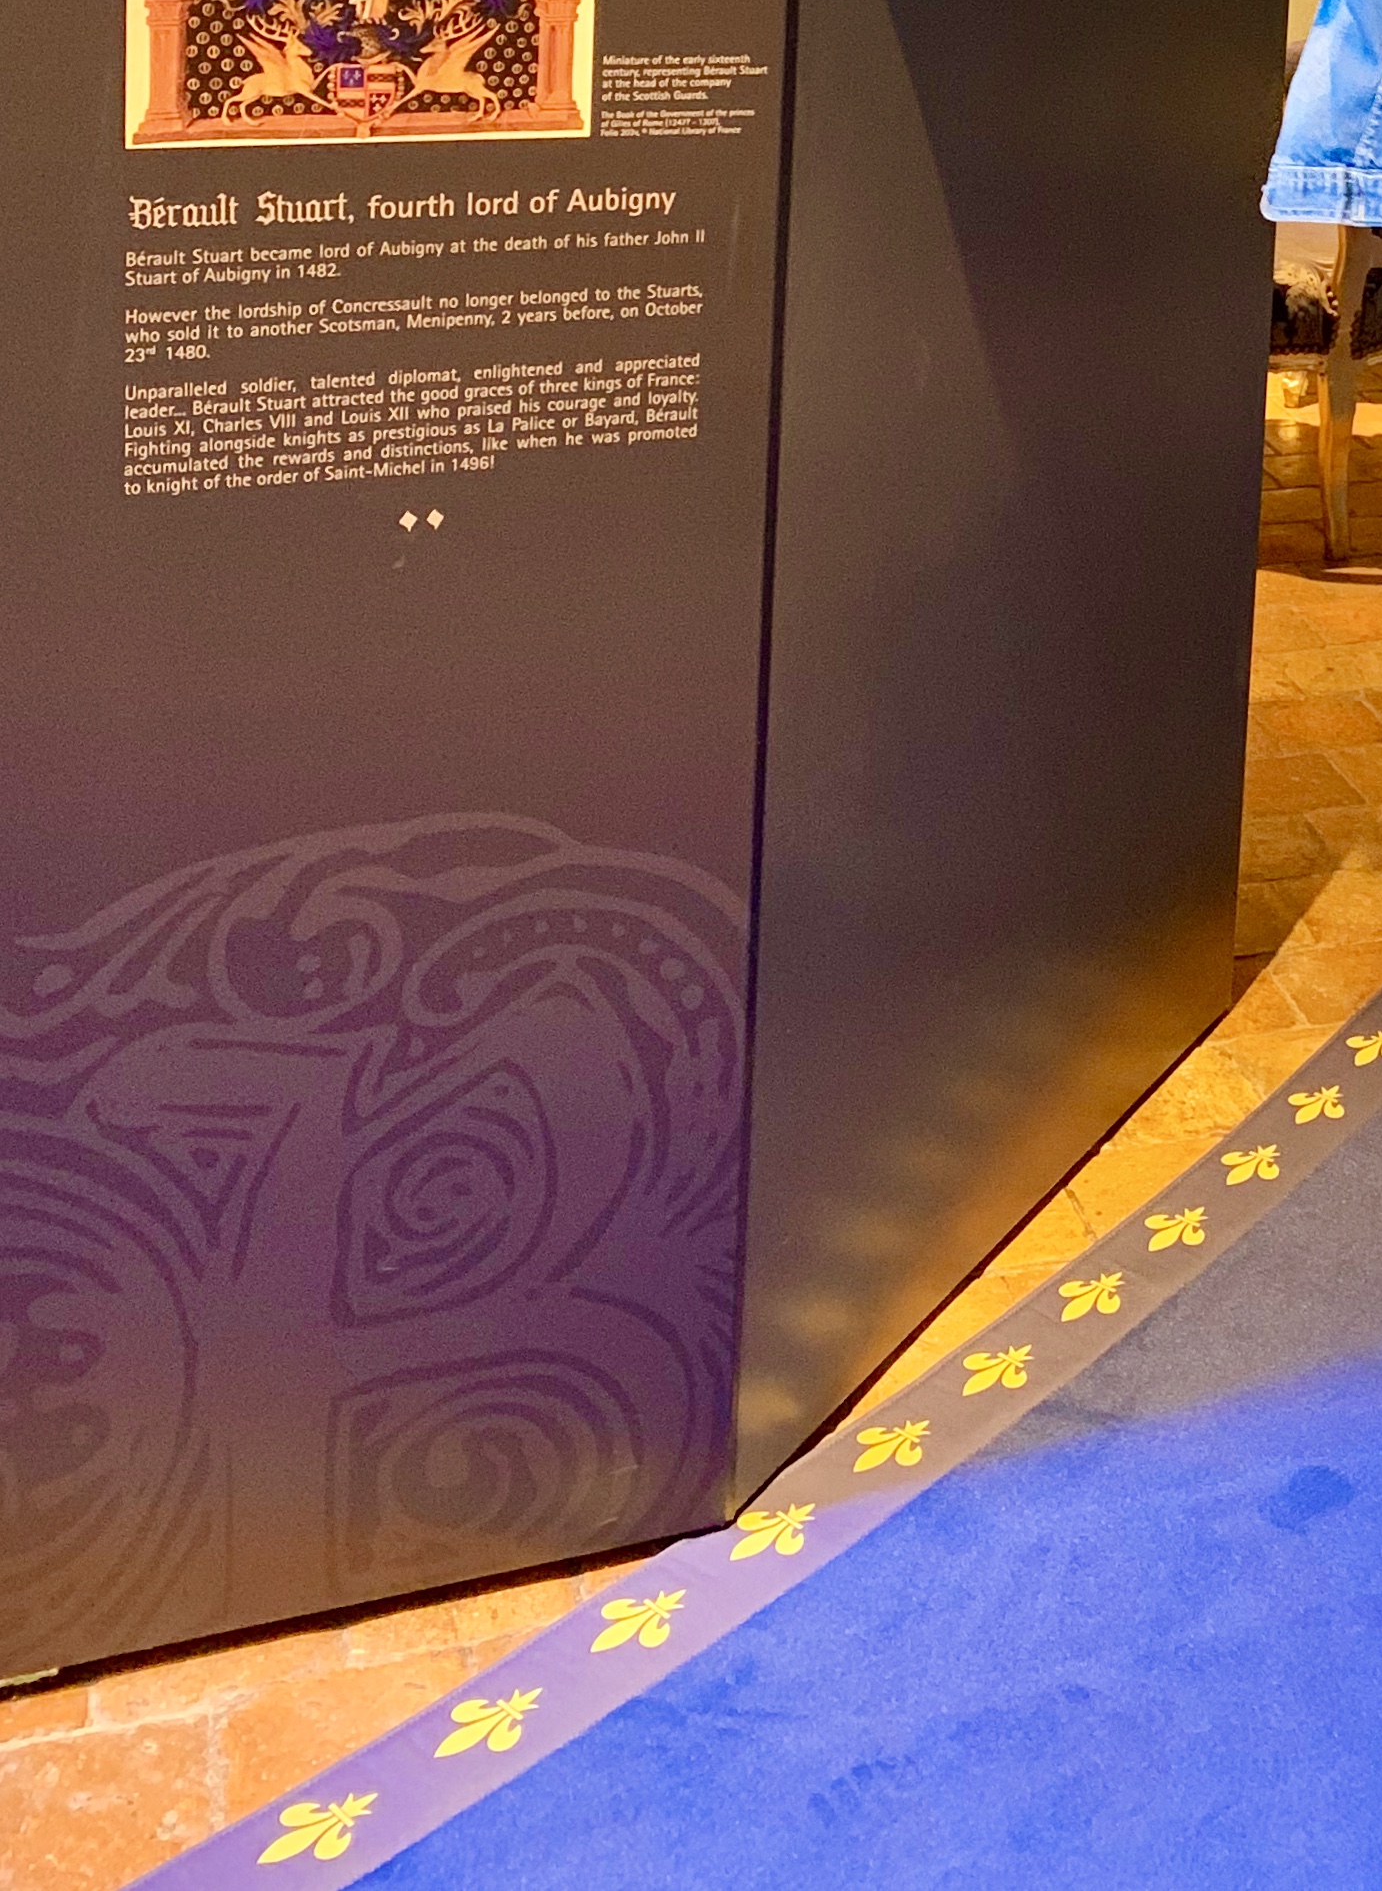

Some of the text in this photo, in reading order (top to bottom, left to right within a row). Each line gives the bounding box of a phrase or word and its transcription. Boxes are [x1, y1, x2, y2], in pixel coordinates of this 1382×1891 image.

[128, 186, 676, 230] Bérault Stuart, fourth lord of Aubigny
[125, 229, 705, 267] Bérault Stuart became lord of Aubigny at the death of his father John II
[124, 262, 341, 286] Stuart of Aubigny in 1482.
